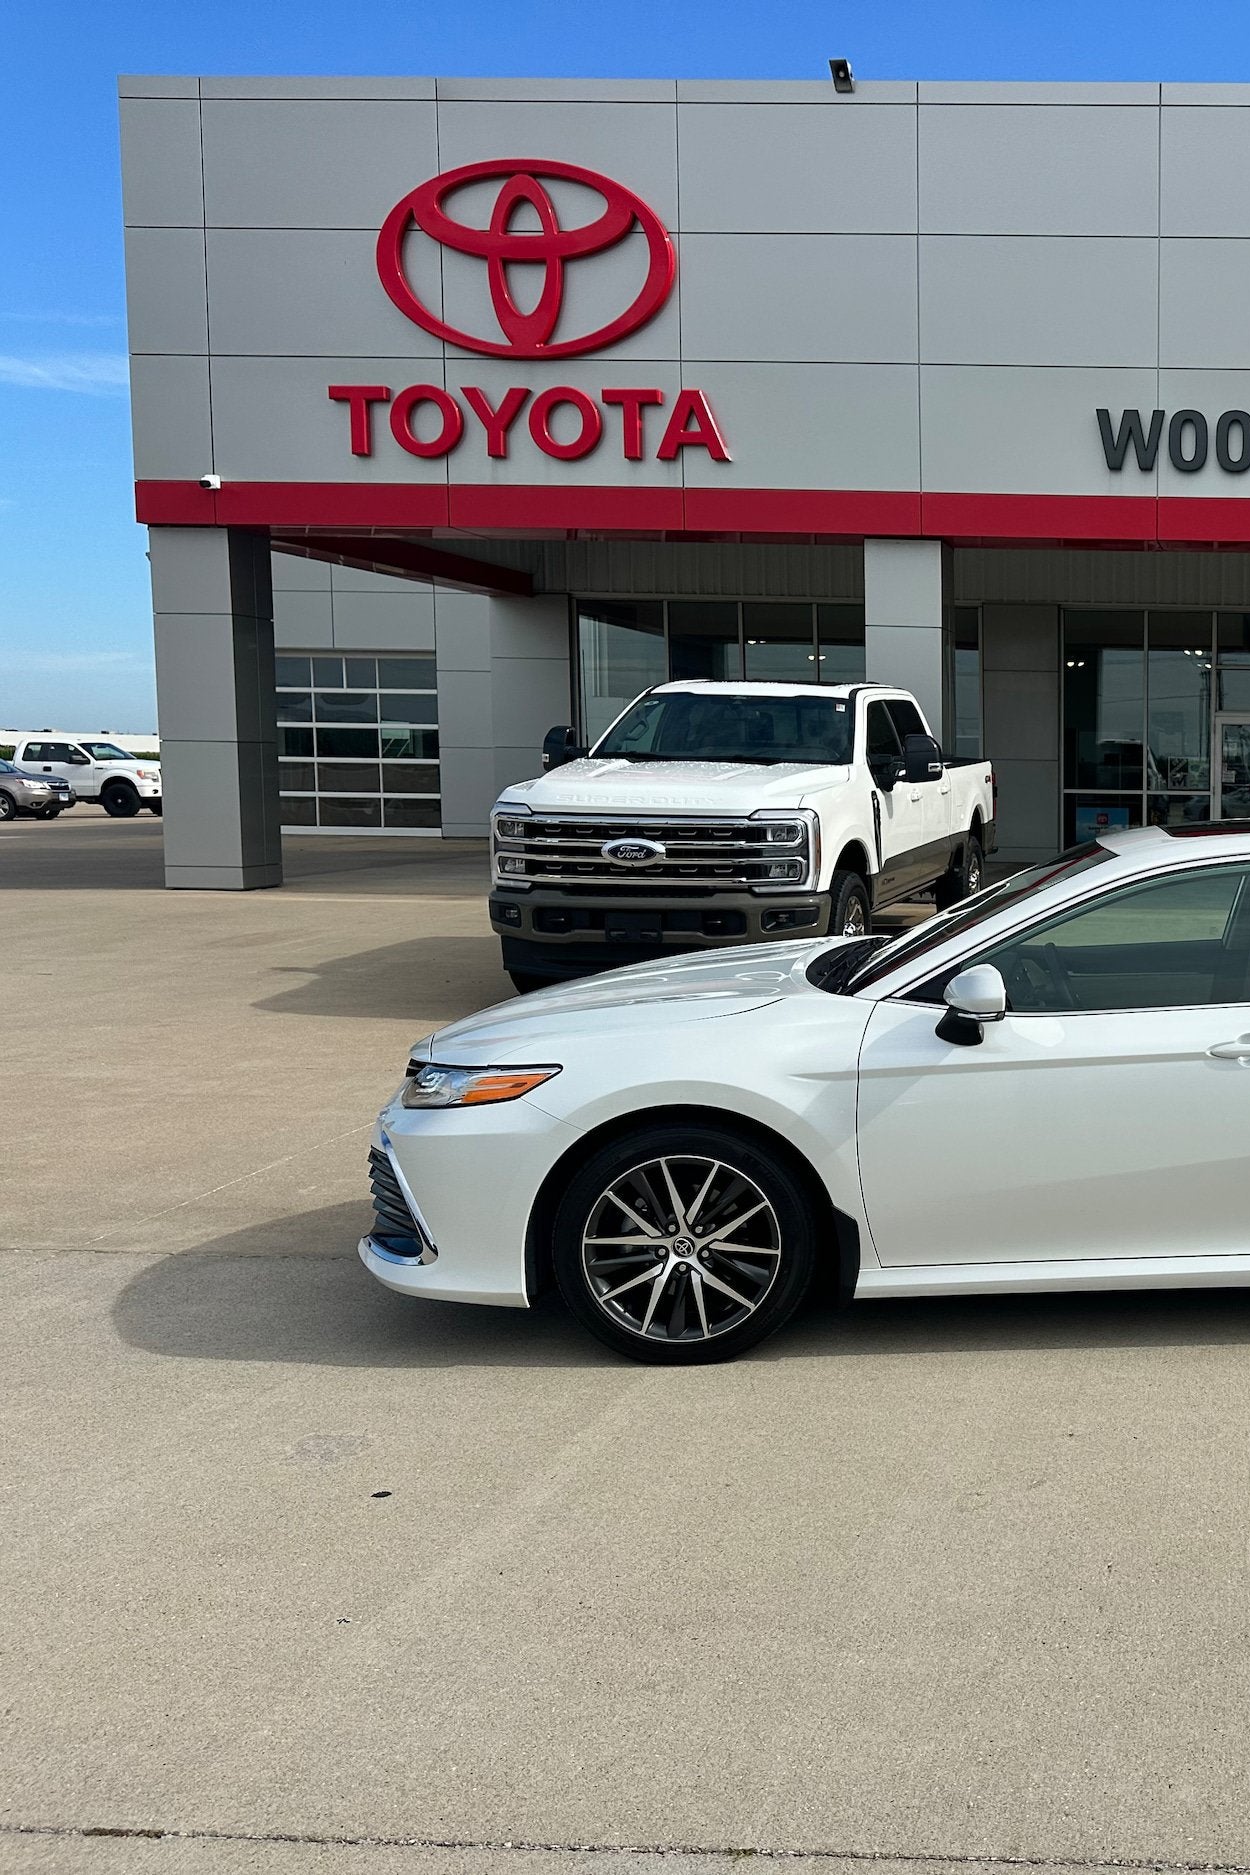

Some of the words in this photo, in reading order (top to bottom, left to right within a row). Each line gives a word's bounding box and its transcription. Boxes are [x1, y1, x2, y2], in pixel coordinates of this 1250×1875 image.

[328, 384, 732, 462] TOYOTA
[556, 794, 645, 805] SUPER
[617, 845, 647, 859] Ford
